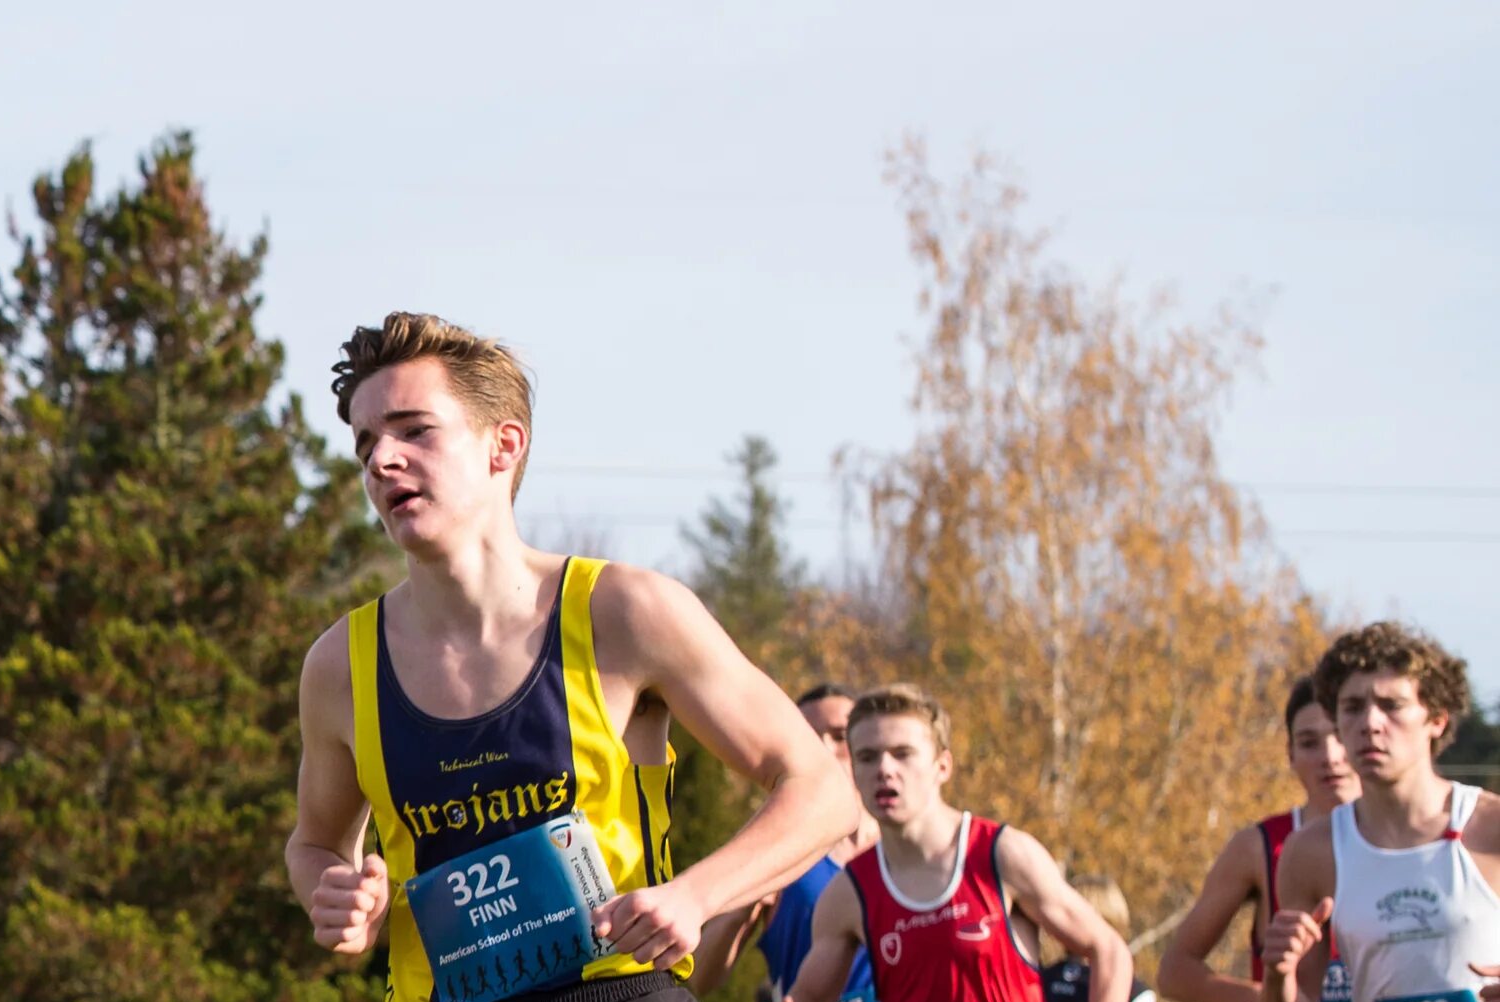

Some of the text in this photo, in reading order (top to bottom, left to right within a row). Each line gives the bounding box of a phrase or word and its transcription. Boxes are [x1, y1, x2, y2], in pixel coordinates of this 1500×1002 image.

[438, 751, 510, 773] Technical Wear
[402, 770, 569, 838] trojans
[446, 853, 520, 907] 322
[574, 863, 591, 896] Division
[580, 846, 607, 902] Championship
[439, 905, 576, 967] American School of The Hague
[468, 893, 518, 927] FINN
